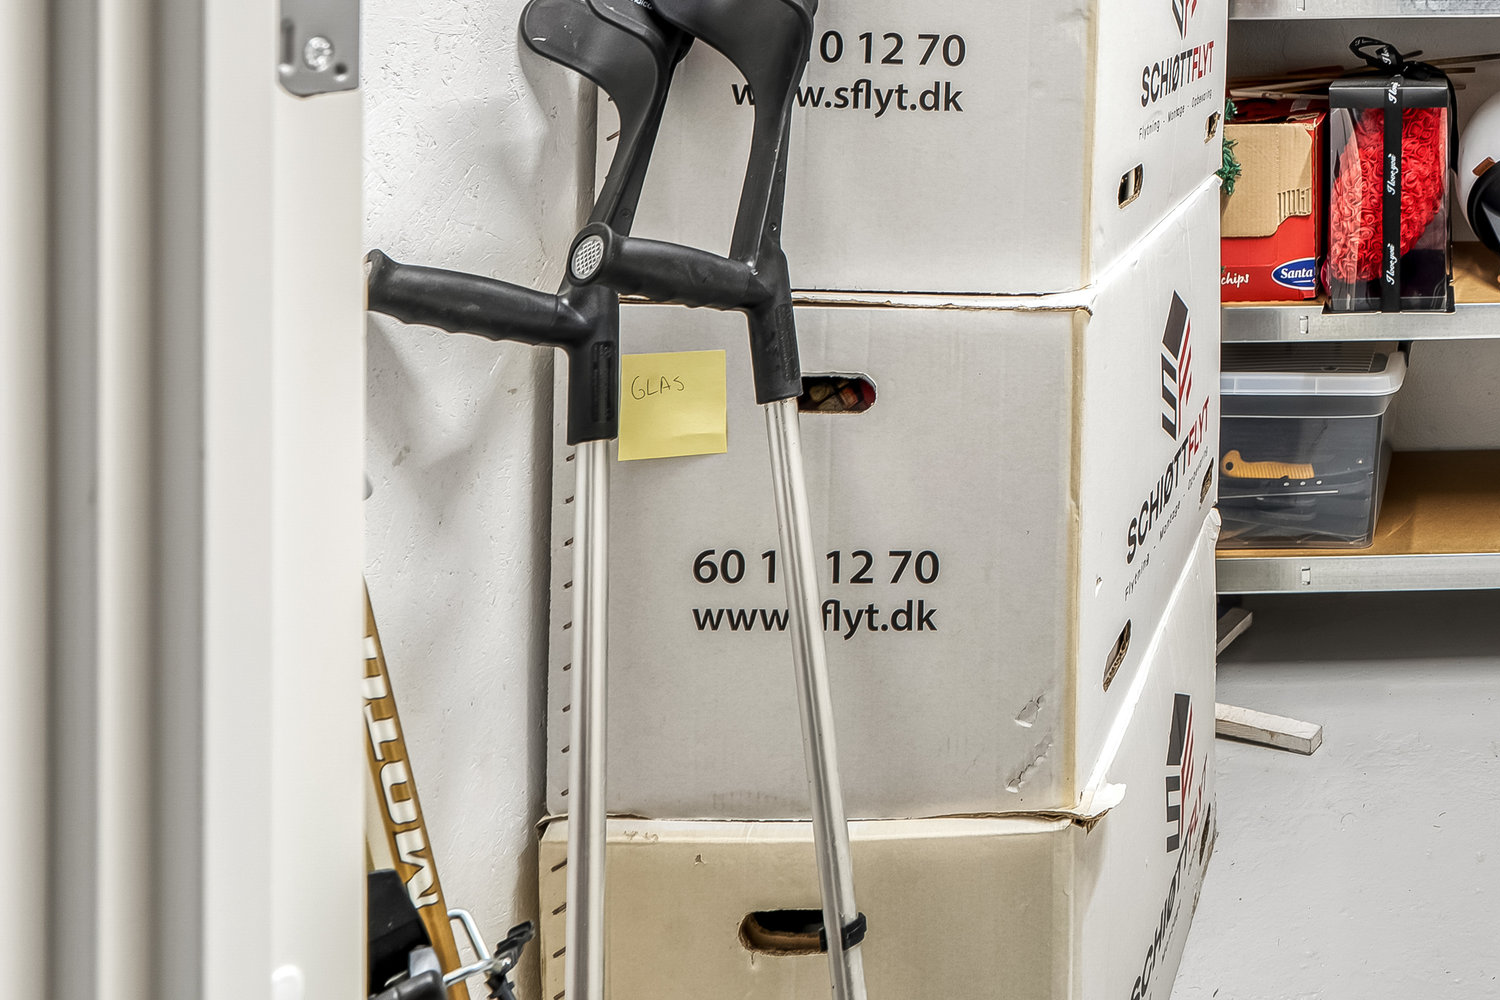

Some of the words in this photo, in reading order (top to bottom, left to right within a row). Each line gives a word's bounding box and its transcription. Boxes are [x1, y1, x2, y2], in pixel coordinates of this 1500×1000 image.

[858, 31, 904, 65] 12
[917, 33, 966, 67] 70
[731, 78, 963, 118] ww.sflyt.dk
[1220, 272, 1249, 288] chips
[1280, 268, 1313, 279] Santa
[631, 375, 685, 400] GLAS
[692, 549, 745, 584] 60
[761, 550, 776, 584] 1
[826, 550, 873, 584] 12
[888, 549, 940, 584] 70
[692, 599, 938, 641] wwwflyt.dk
